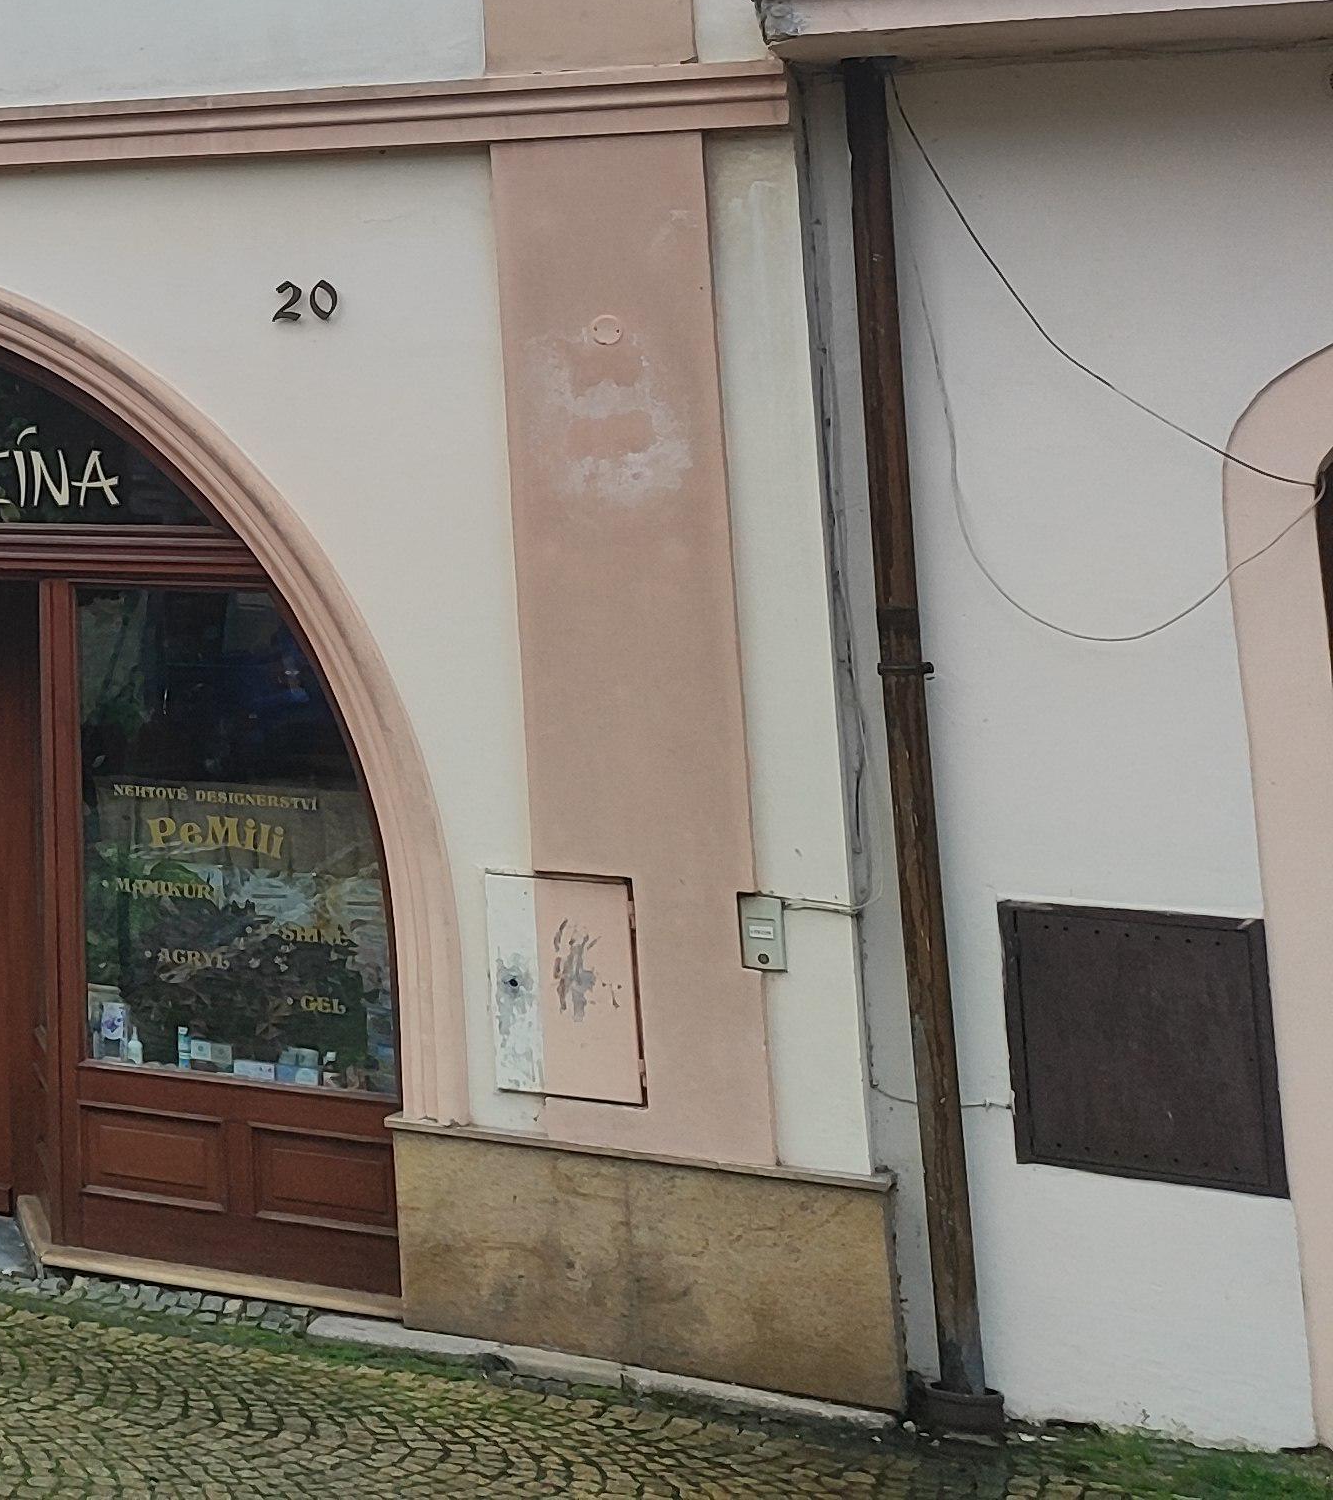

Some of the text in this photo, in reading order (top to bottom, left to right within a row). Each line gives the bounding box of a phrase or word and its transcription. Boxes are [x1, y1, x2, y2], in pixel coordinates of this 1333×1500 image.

[272, 280, 337, 322] 20
[114, 784, 318, 811] NEHTOVÉ DESIGNERSTVÍ
[146, 814, 285, 860] PeMili
[158, 947, 231, 970] ACRYL
[300, 994, 347, 1015] GEL
